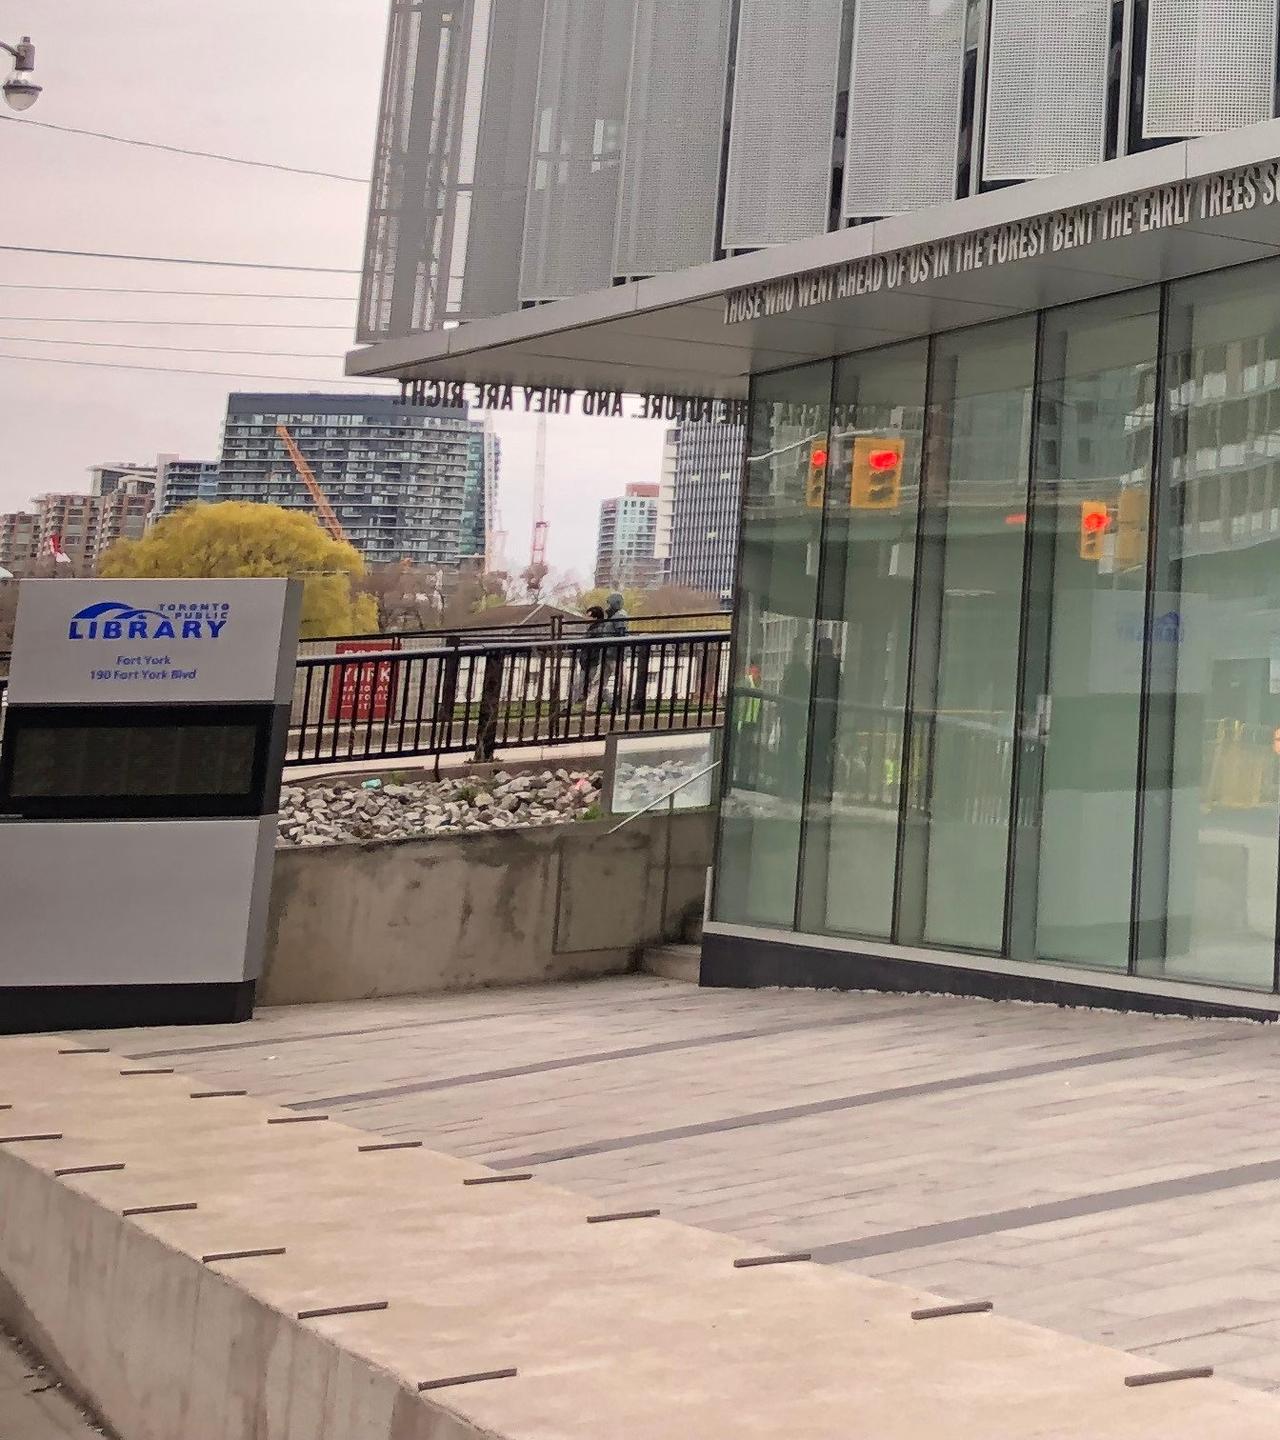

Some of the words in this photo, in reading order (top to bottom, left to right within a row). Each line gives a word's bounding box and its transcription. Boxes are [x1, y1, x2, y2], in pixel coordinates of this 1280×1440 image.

[724, 285, 762, 324] THOSE
[765, 275, 795, 316] WHO
[798, 270, 835, 308] WENT
[837, 259, 884, 299] AHEAD
[886, 254, 904, 289] OF
[909, 250, 928, 285] US
[932, 244, 949, 279] IN
[954, 234, 984, 274] THE
[988, 220, 1047, 266] FOREST
[1052, 210, 1095, 252] BENT
[1101, 196, 1134, 241] THE
[1139, 184, 1192, 234] EARLY
[1199, 168, 1256, 219] TREES
[159, 602, 230, 612] TORONTO
[174, 611, 229, 620] PUBLIC
[68, 620, 228, 640] LIBRARY
[116, 655, 142, 666] Fort
[144, 655, 172, 665] York
[90, 669, 112, 680] 190
[113, 669, 139, 680] Fort
[141, 669, 168, 680] York
[170, 669, 197, 680] Blvd
